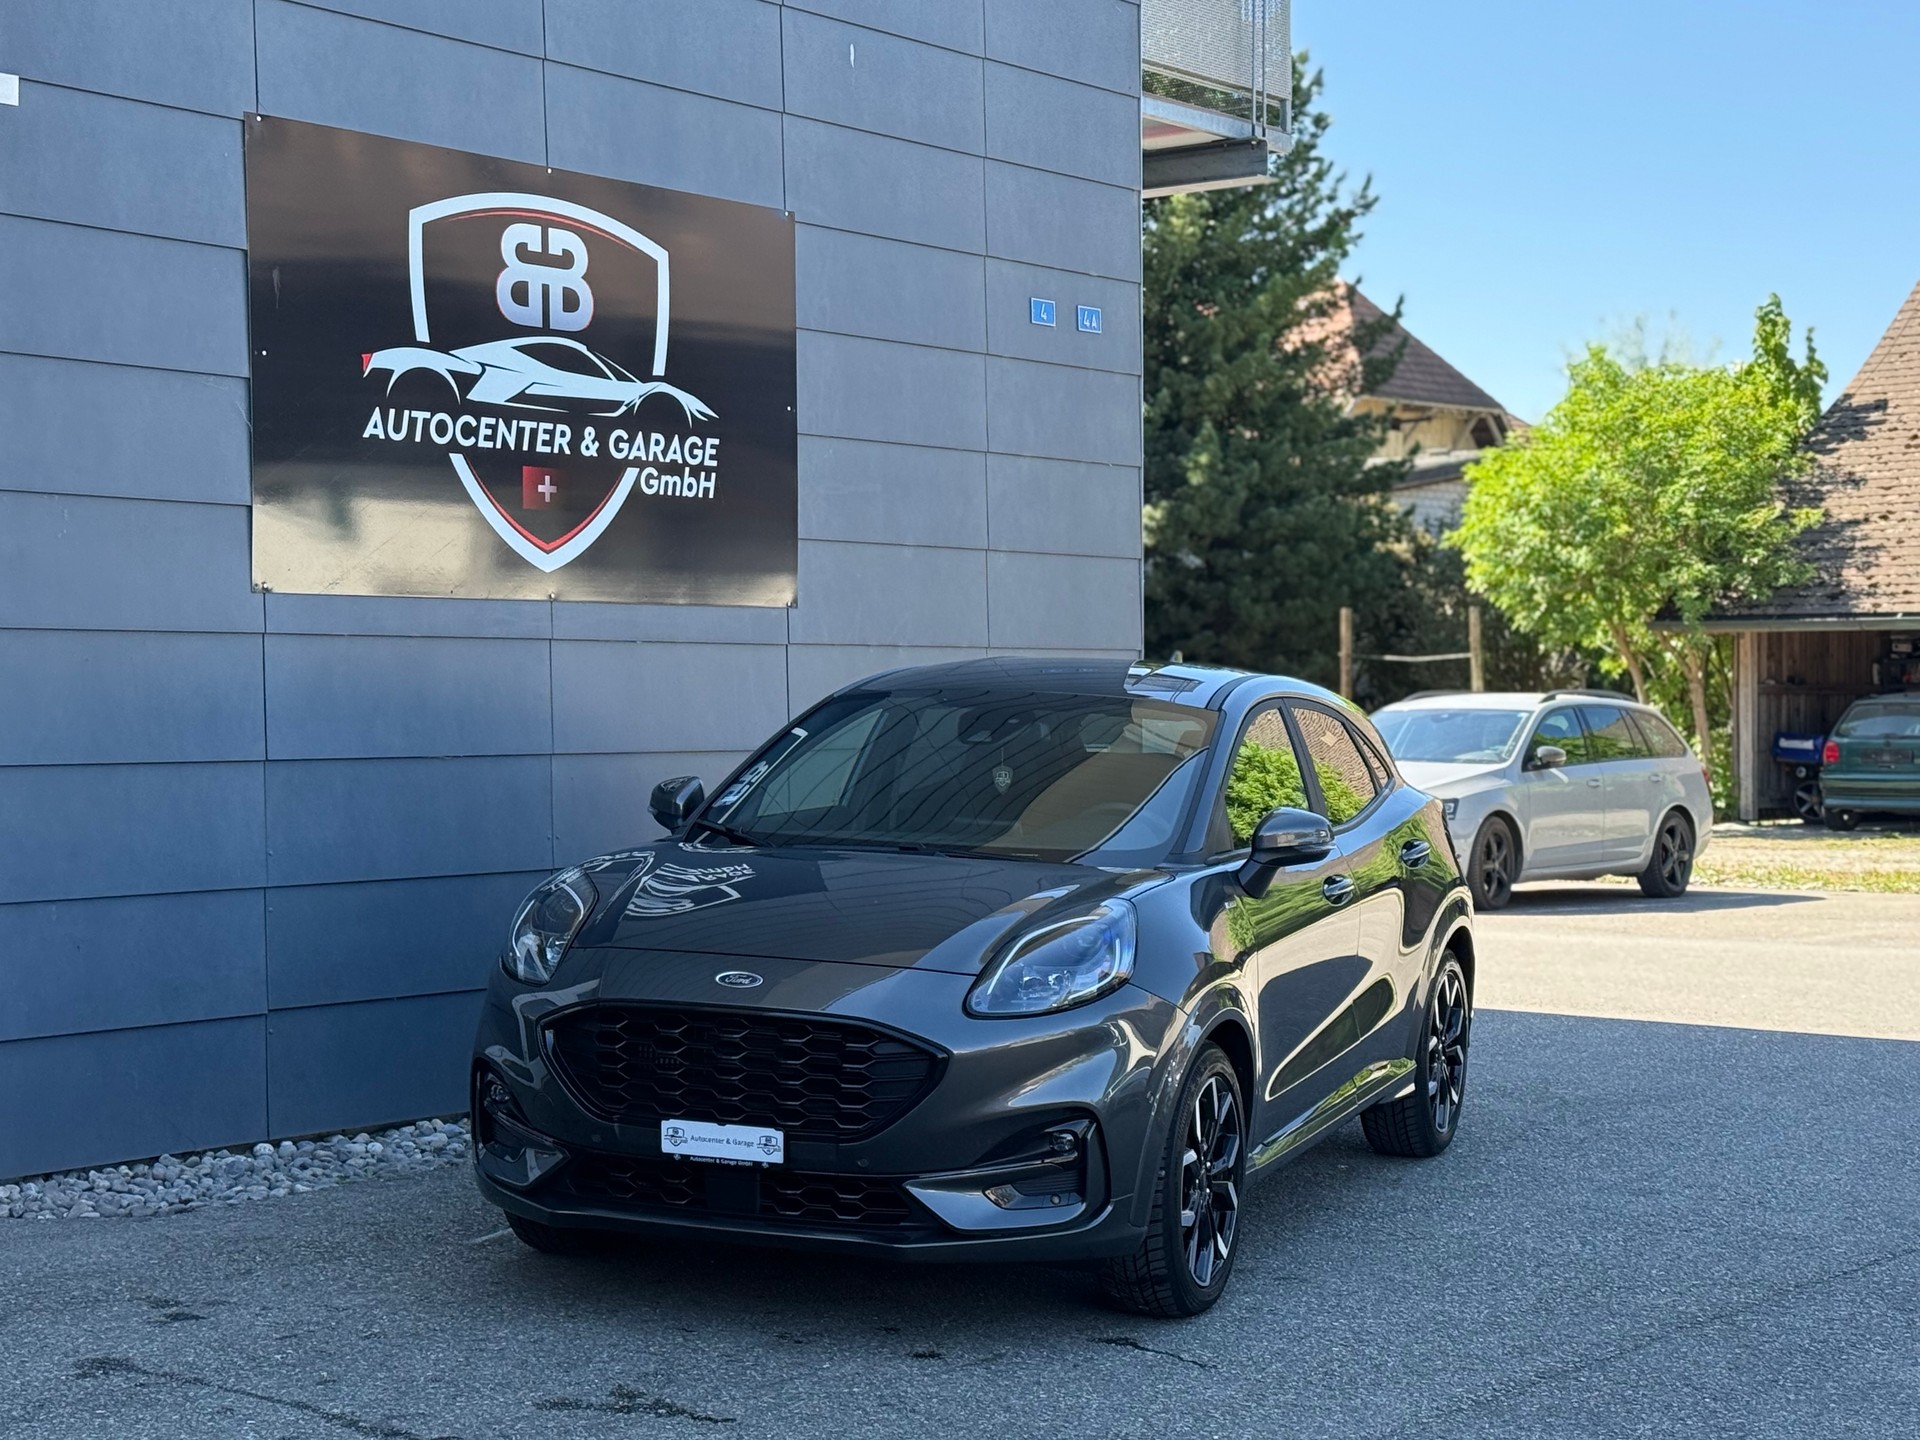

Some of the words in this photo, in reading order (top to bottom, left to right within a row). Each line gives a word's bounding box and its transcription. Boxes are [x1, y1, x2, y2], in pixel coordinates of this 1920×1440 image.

[1040, 303, 1047, 320] 4
[1083, 310, 1097, 329] 4A
[363, 406, 572, 455] AUTOCENTER
[580, 426, 600, 457] &
[609, 429, 720, 467] GARAGE
[640, 467, 716, 499] GmbH
[725, 974, 753, 984] Ford
[690, 1135, 724, 1144] Autocenter
[732, 1138, 755, 1148] Garage
